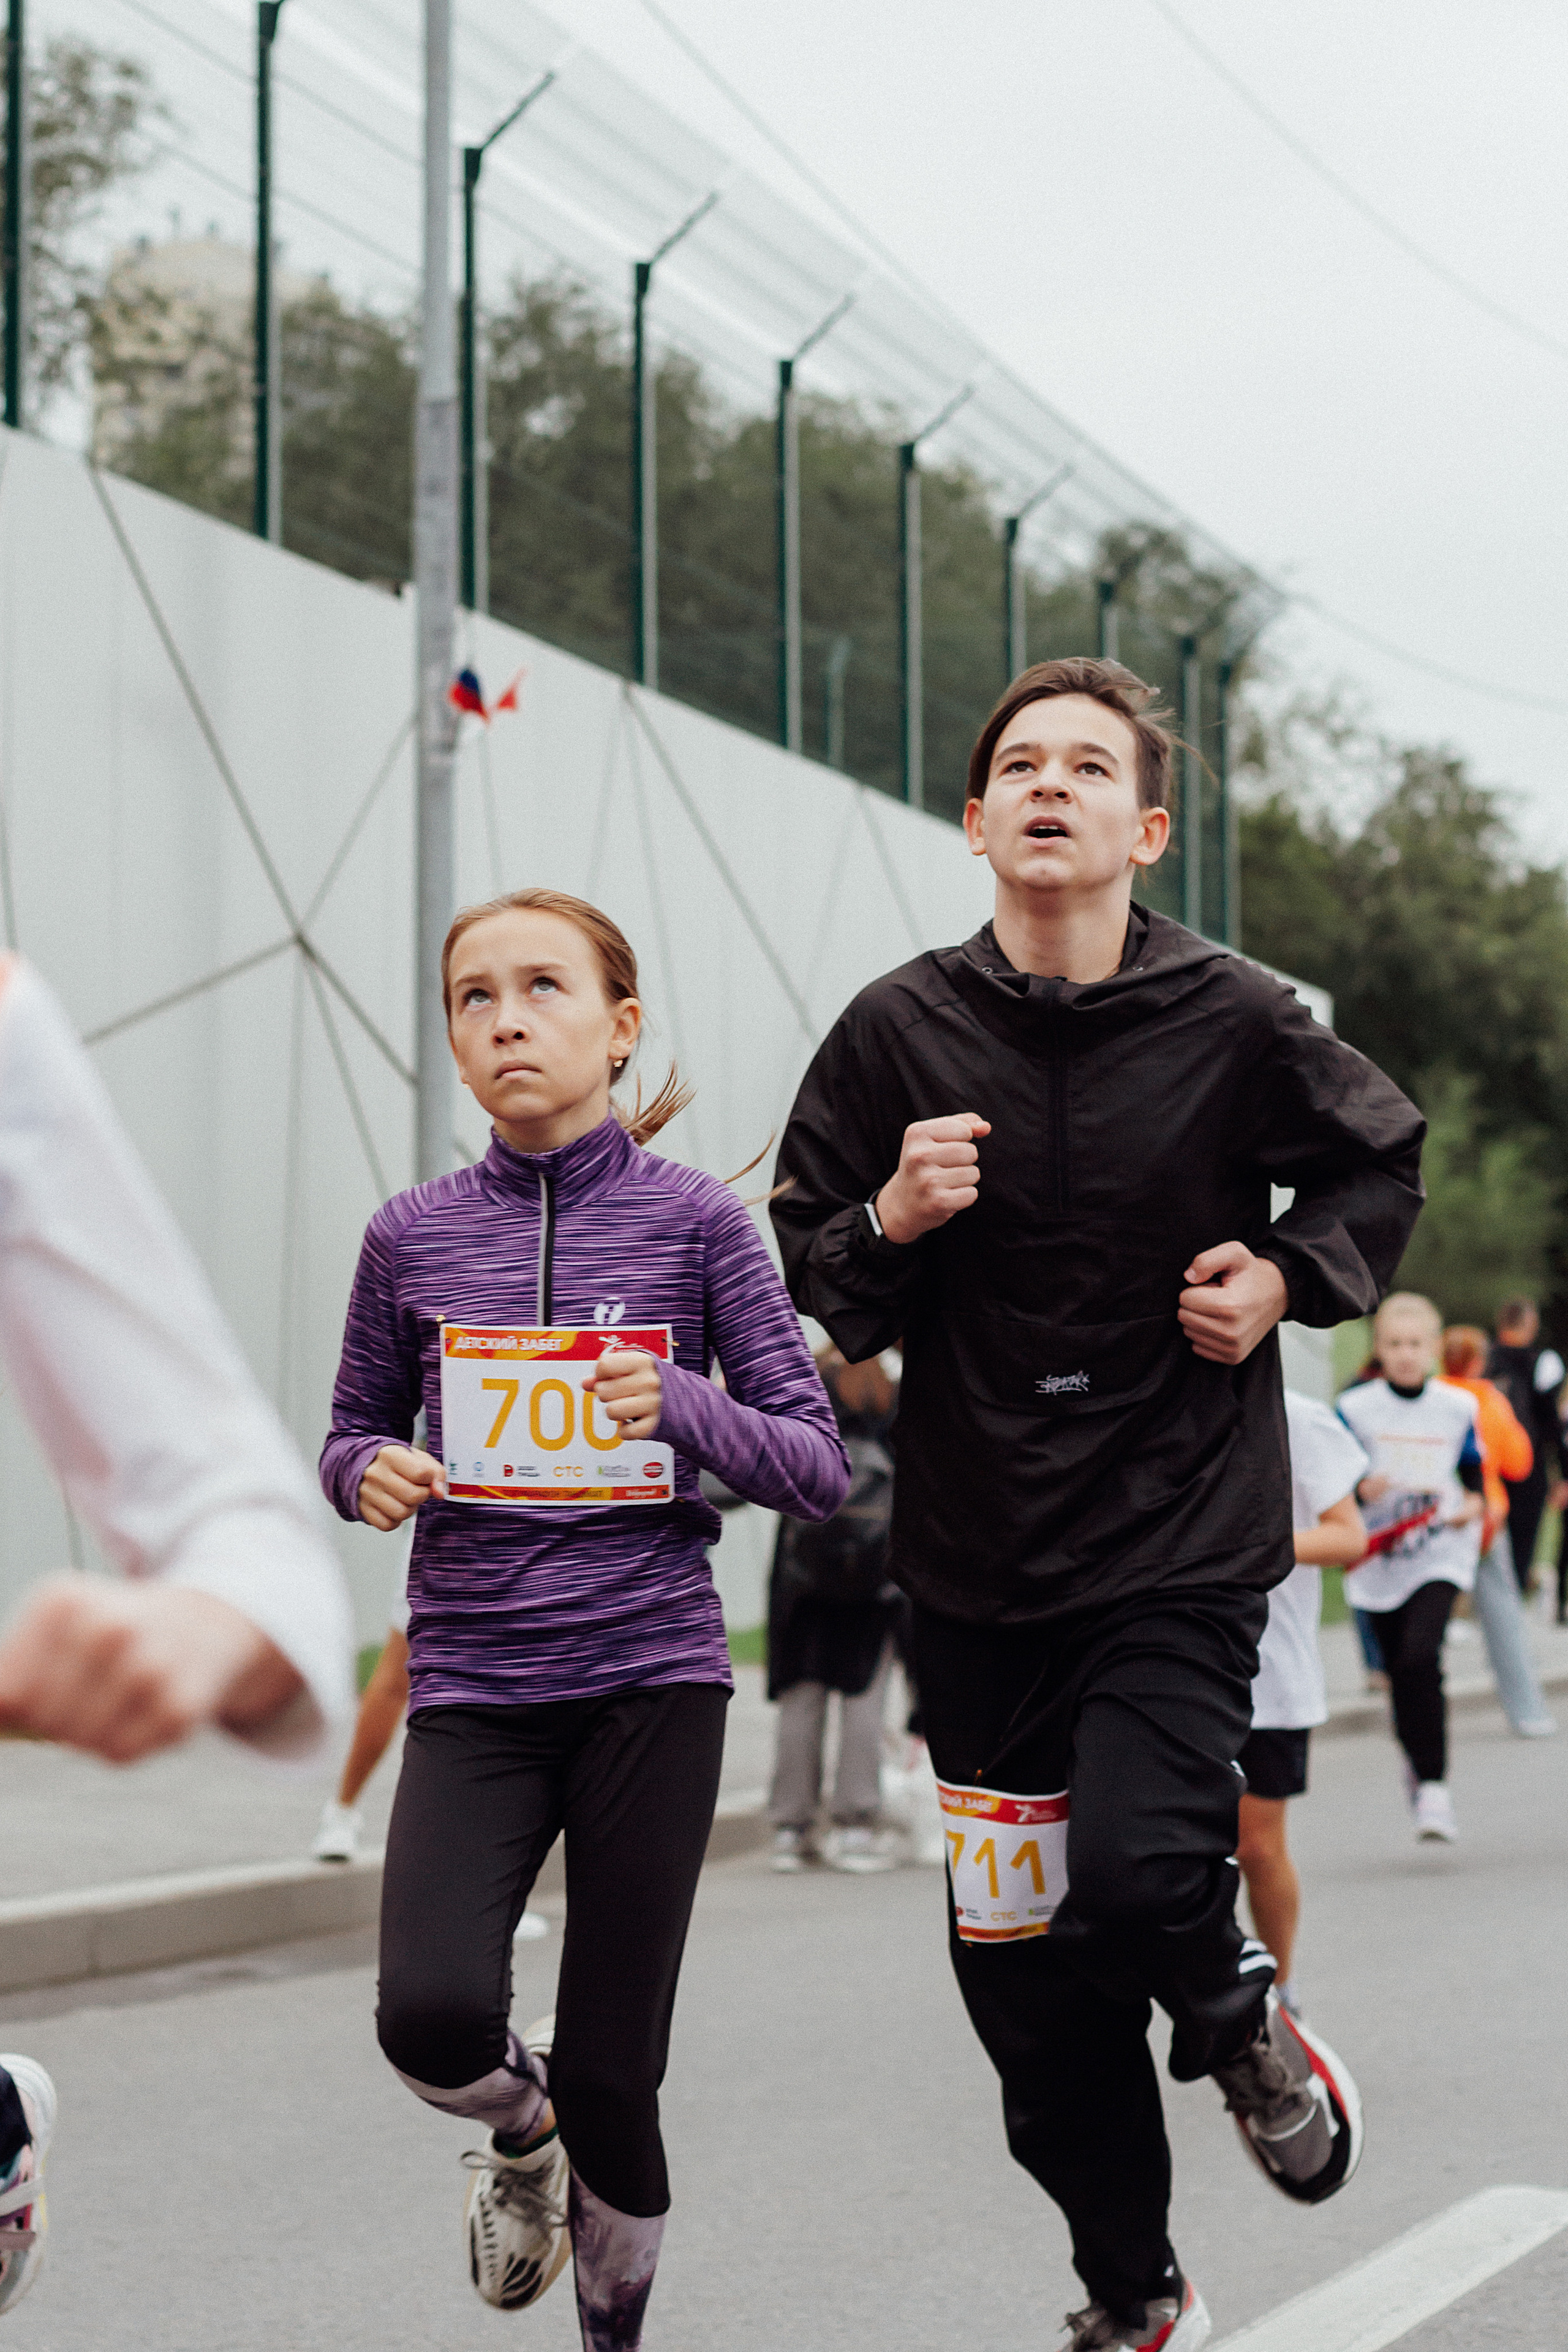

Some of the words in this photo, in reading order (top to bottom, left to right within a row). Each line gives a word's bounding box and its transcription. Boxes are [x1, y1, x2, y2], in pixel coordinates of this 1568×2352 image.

[454, 1335, 518, 1350] ДЕТСКИЙ
[519, 1338, 564, 1351] ЗАБЕГ
[945, 1829, 1046, 1899] 711
